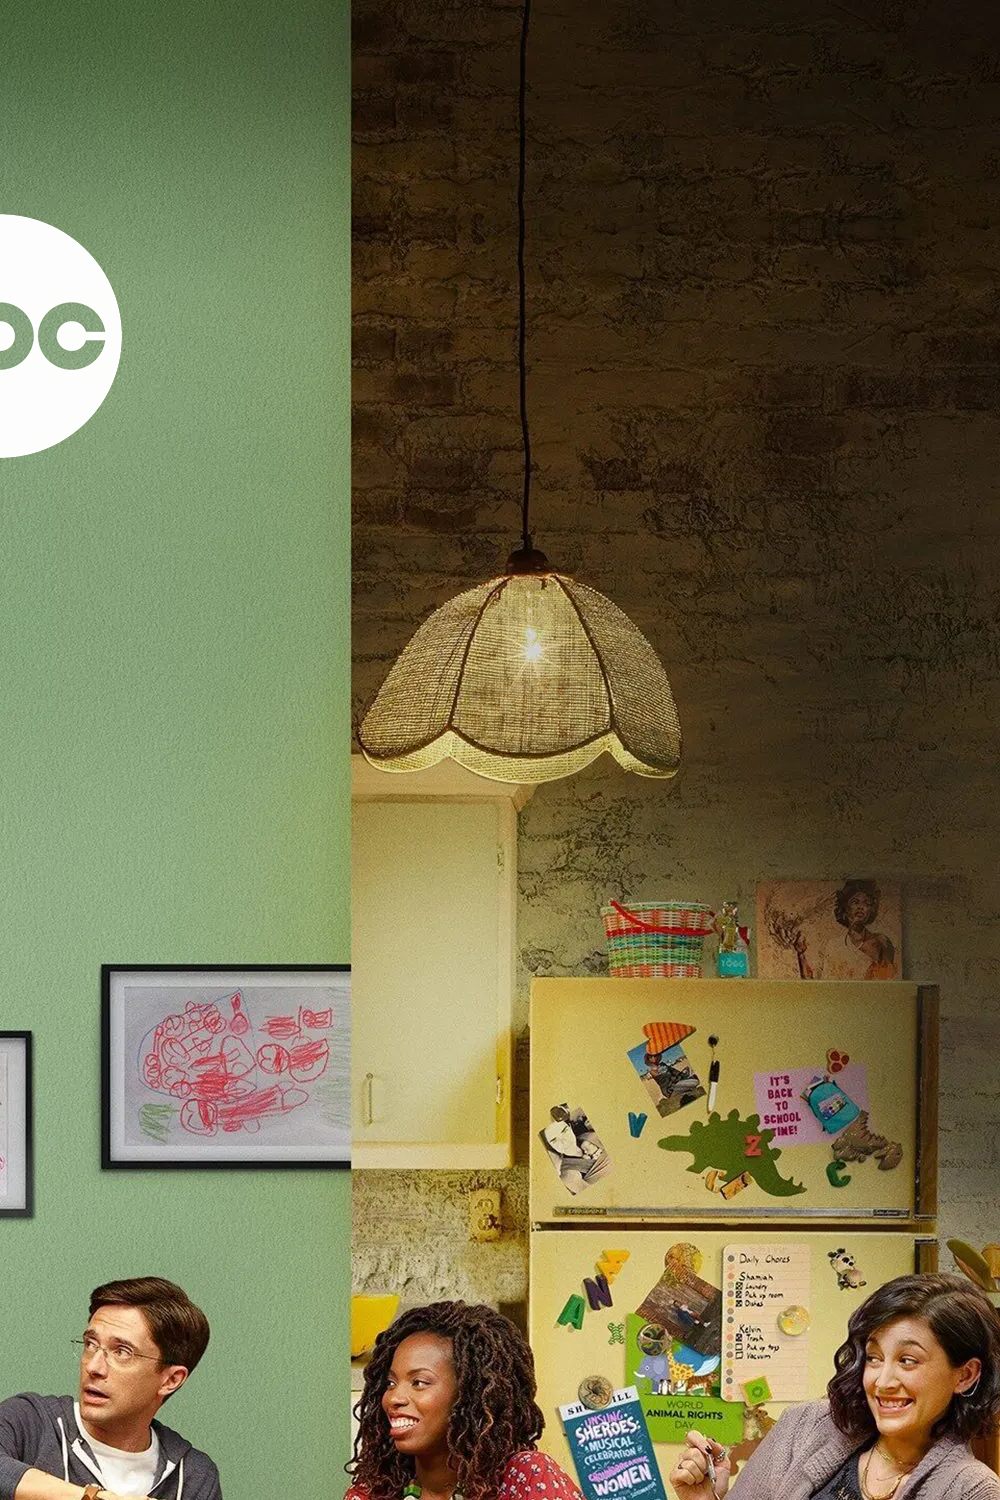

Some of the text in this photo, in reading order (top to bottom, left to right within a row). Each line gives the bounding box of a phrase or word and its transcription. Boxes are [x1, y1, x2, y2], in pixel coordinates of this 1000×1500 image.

[769, 1075, 790, 1086] IT'S
[767, 1088, 793, 1099] BACK
[775, 1101, 789, 1111] TO
[763, 1112, 801, 1125] SCHOOL
[772, 1126, 798, 1137] TIME!
[740, 1253, 791, 1266] Daily Chores
[739, 1324, 762, 1334] Kelvin
[567, 1392, 632, 1415] SHILL
[666, 1400, 704, 1409] WORLD
[584, 1410, 624, 1427] UNSUNG
[646, 1409, 723, 1420] ANIMAL RIGHTS
[674, 1421, 694, 1429] DAY
[588, 1436, 635, 1452] MUSICAL
[584, 1447, 637, 1466] CELEBRATION
[592, 1463, 653, 1496] WOMEN
